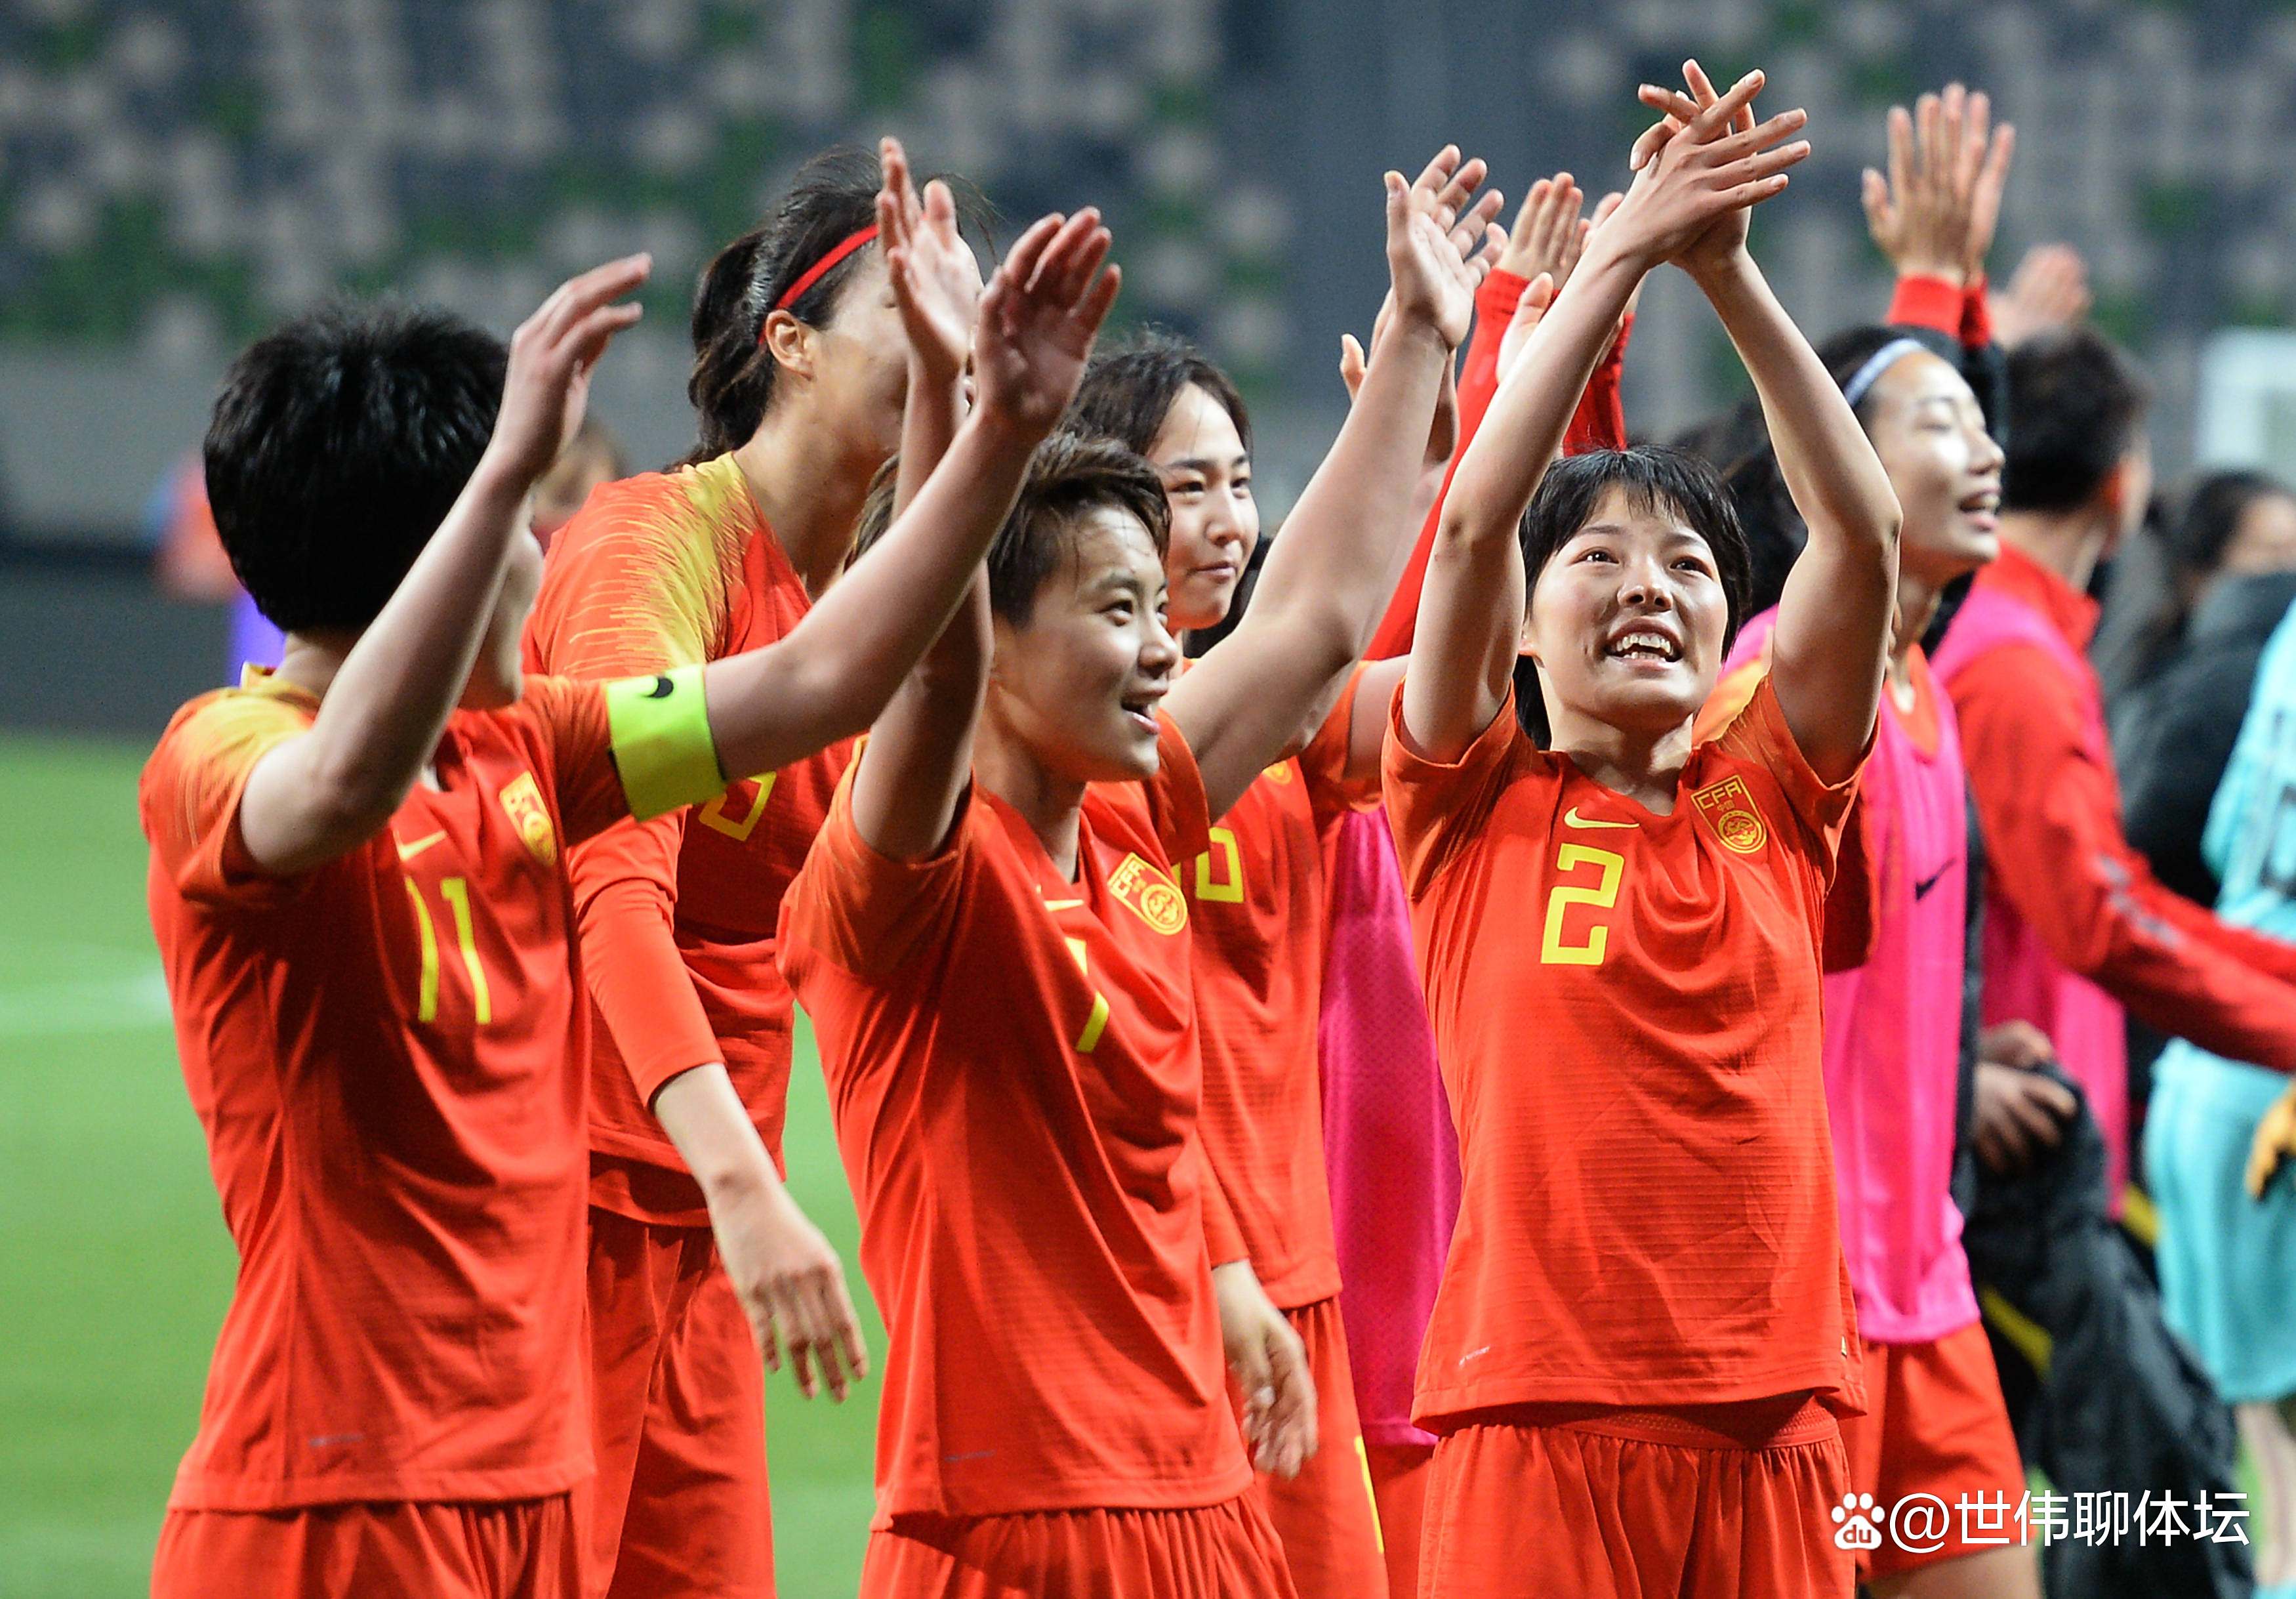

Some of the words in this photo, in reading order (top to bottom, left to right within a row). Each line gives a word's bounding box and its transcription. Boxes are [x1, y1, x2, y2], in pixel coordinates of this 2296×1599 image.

[1696, 780, 1742, 810] CFA
[404, 874, 492, 1025] 11
[1541, 842, 1625, 966] 2
